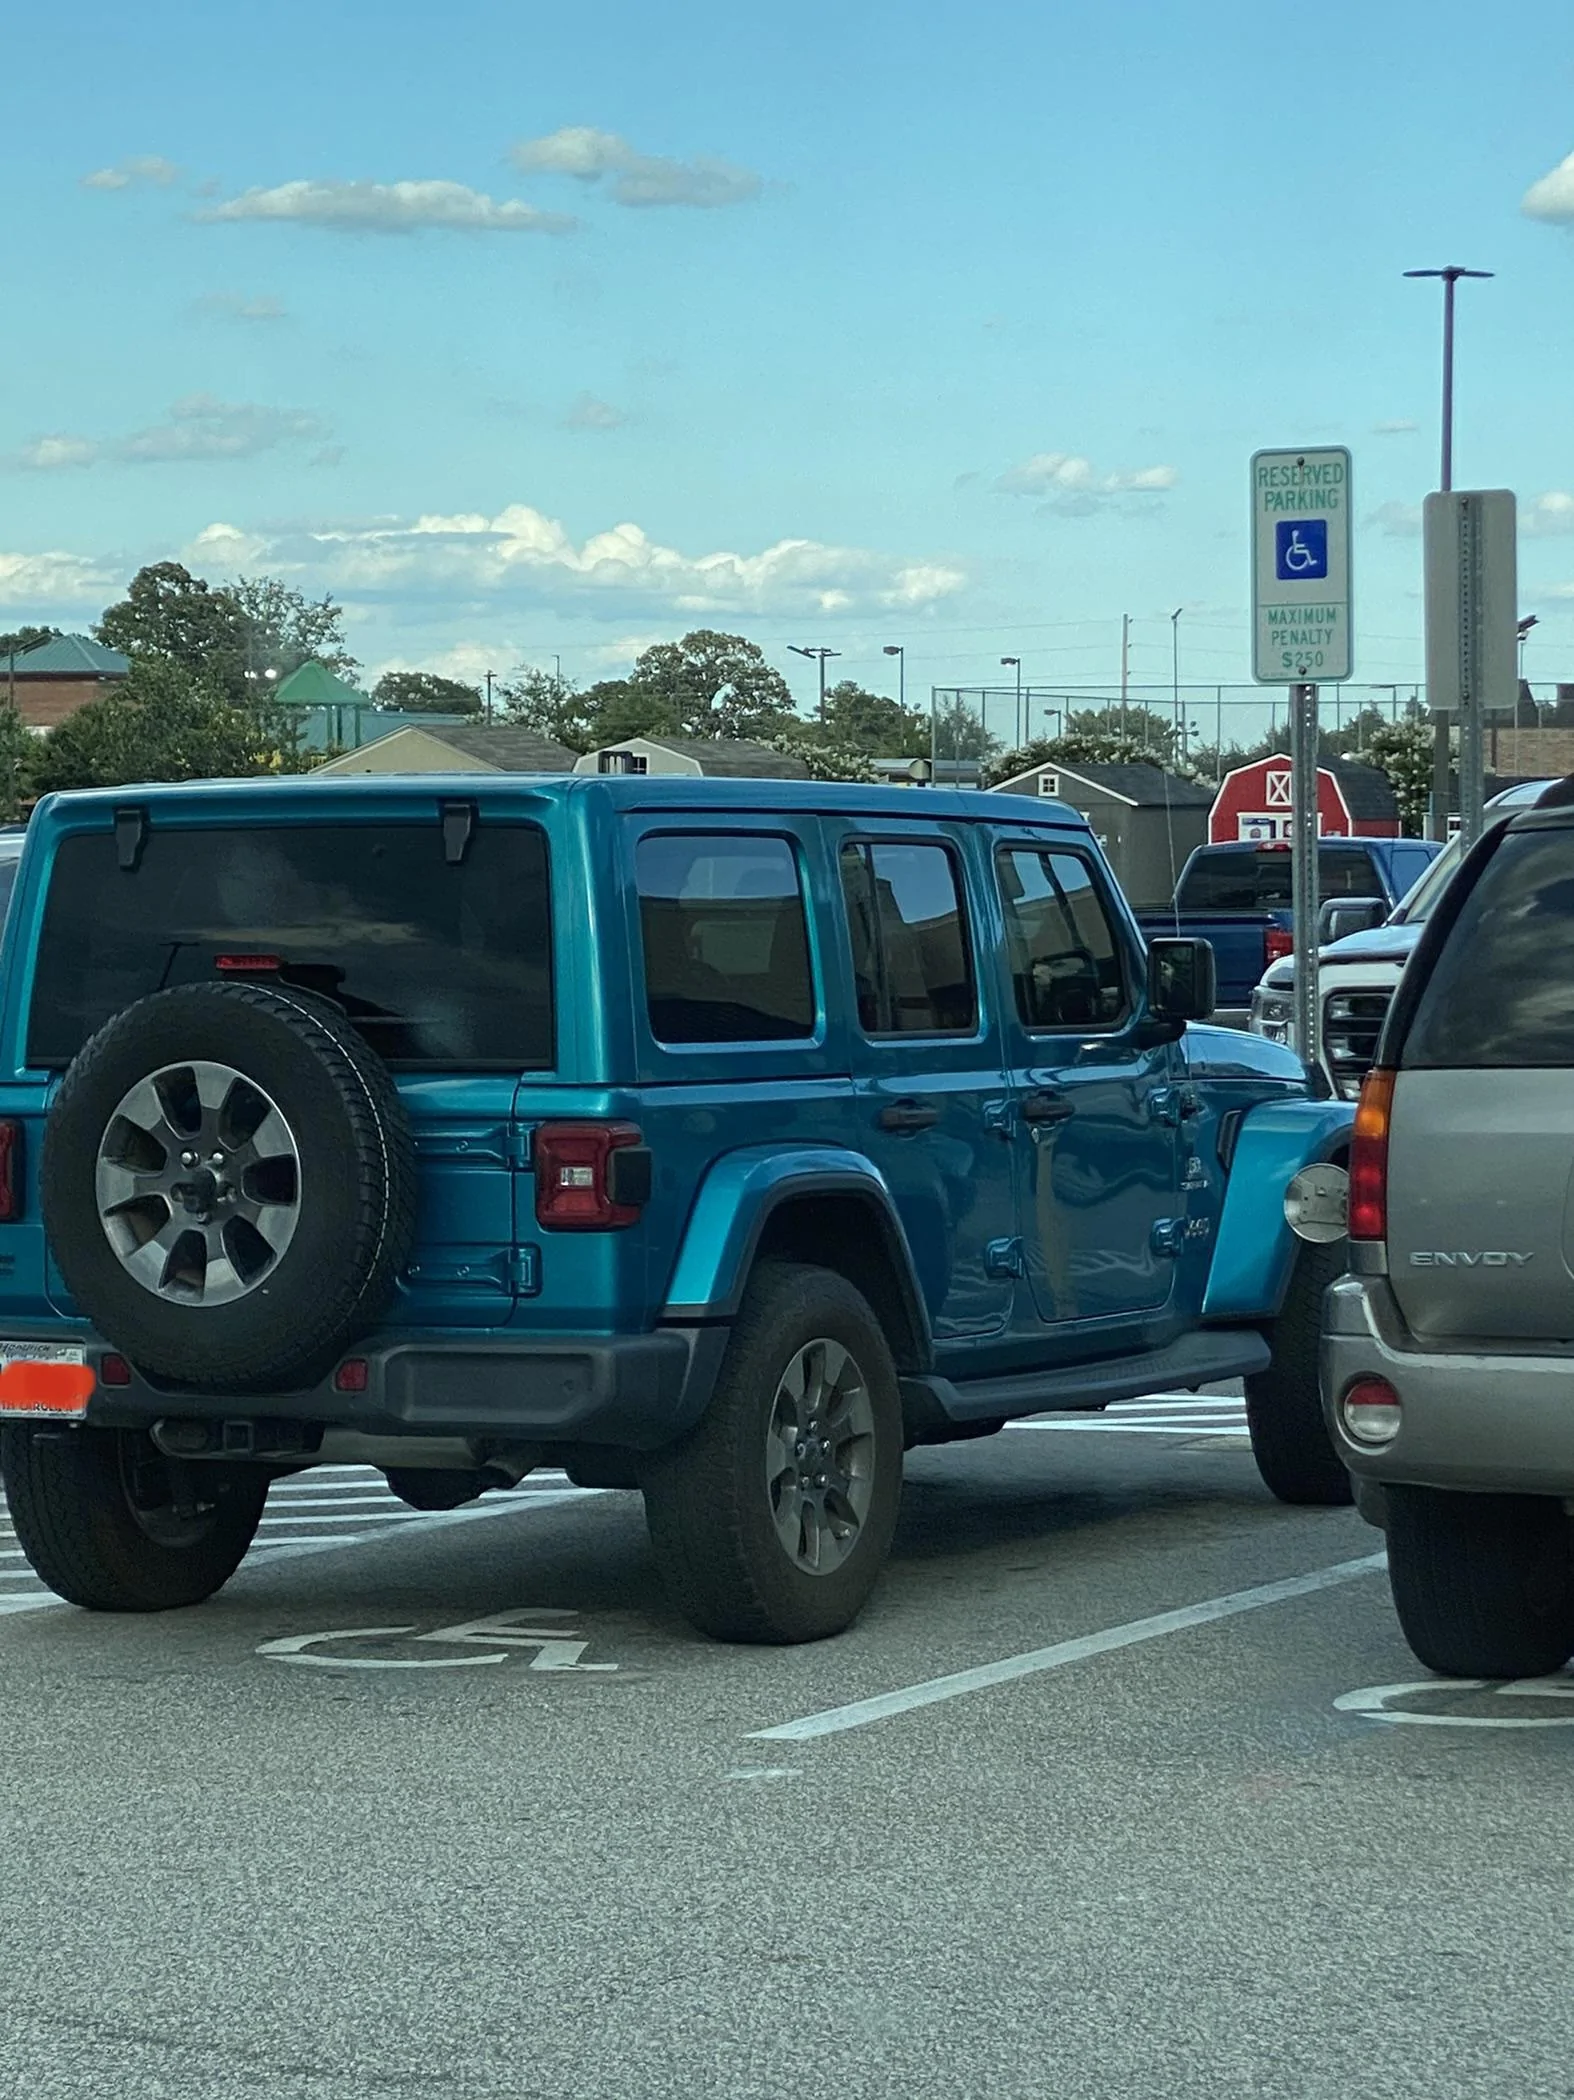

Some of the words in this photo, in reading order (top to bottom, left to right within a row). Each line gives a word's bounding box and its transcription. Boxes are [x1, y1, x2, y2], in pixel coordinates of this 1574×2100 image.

[1258, 463, 1344, 488] RESERVED
[1264, 488, 1339, 512] PARKING
[1267, 607, 1337, 626] MAXIMUM
[1271, 629, 1334, 646] PENALTY
[1410, 1251, 1535, 1268] ENVOY
